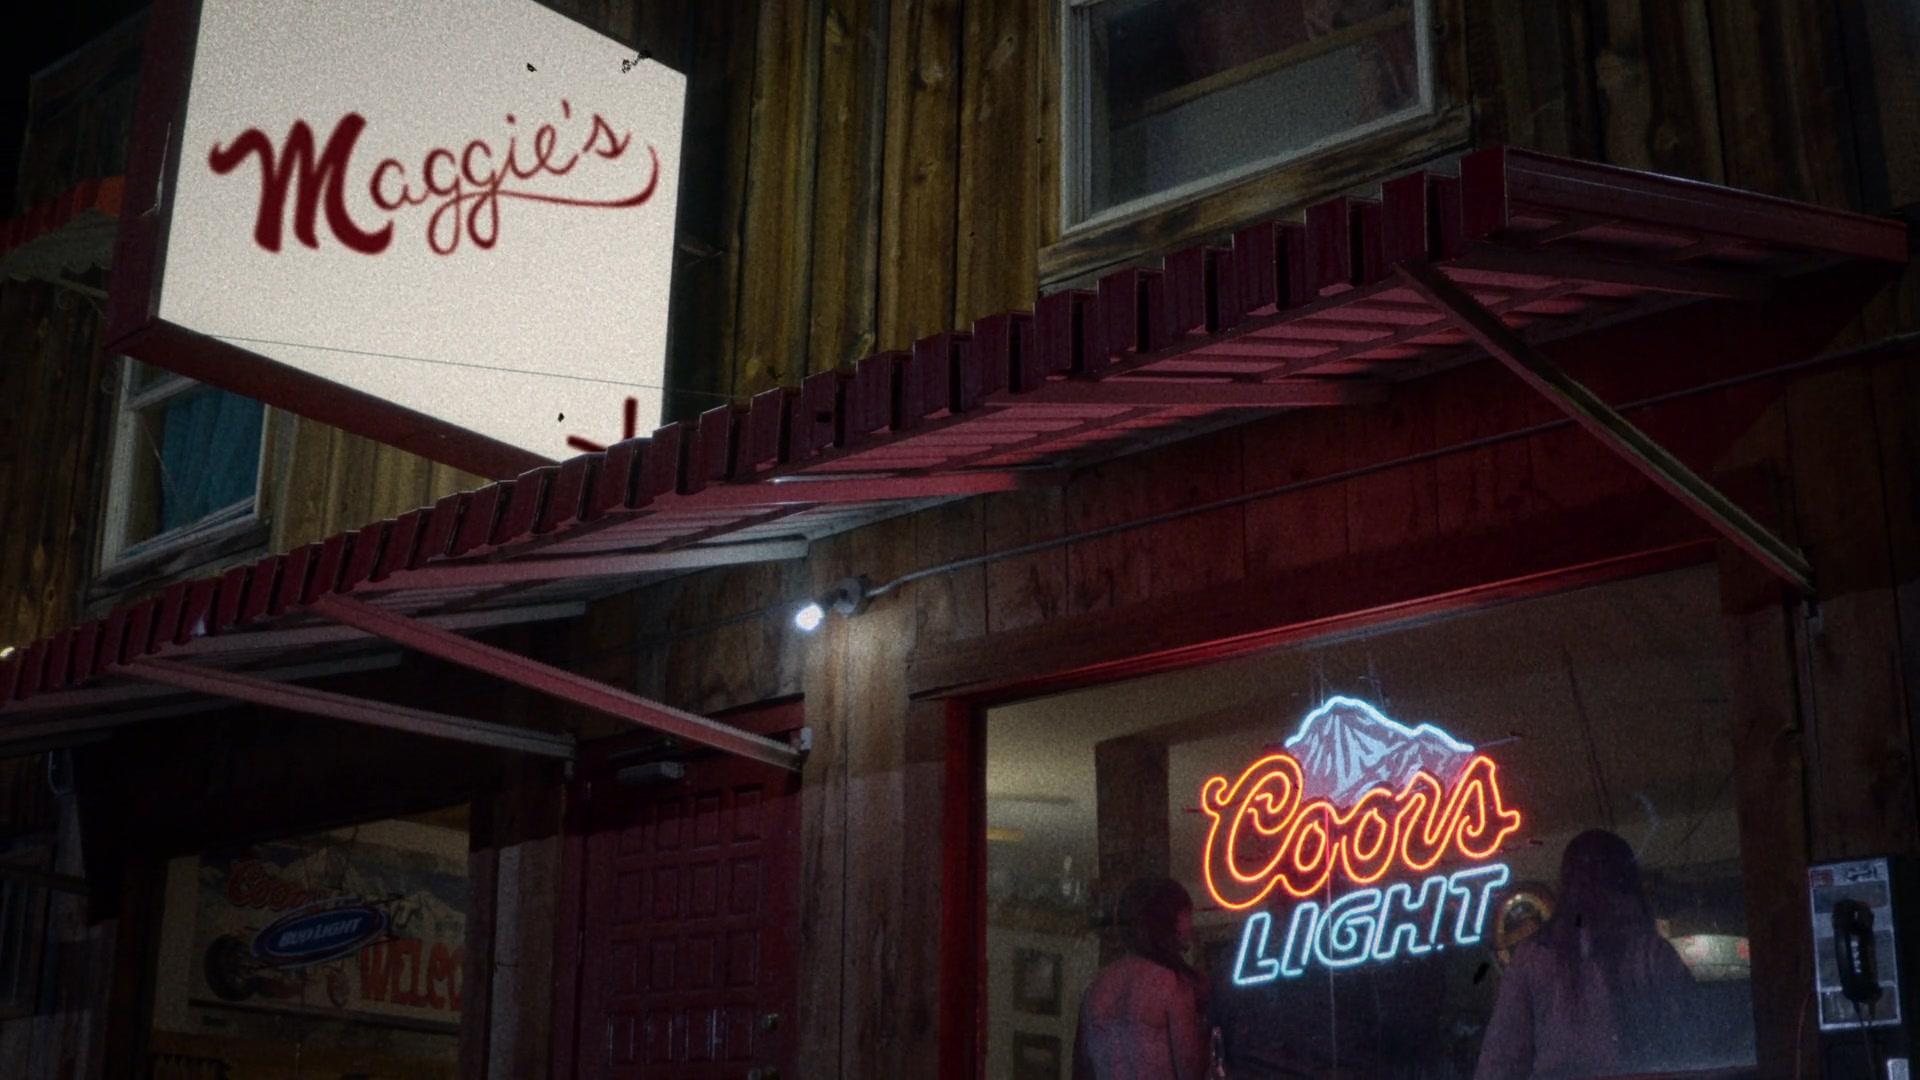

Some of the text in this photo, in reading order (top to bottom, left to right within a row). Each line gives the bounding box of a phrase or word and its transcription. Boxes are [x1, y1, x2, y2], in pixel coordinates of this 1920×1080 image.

[208, 100, 659, 255] Maggie's
[1202, 754, 1521, 910] Coors
[277, 917, 363, 948] BUD LIGHT
[1232, 863, 1511, 987] LIGHT
